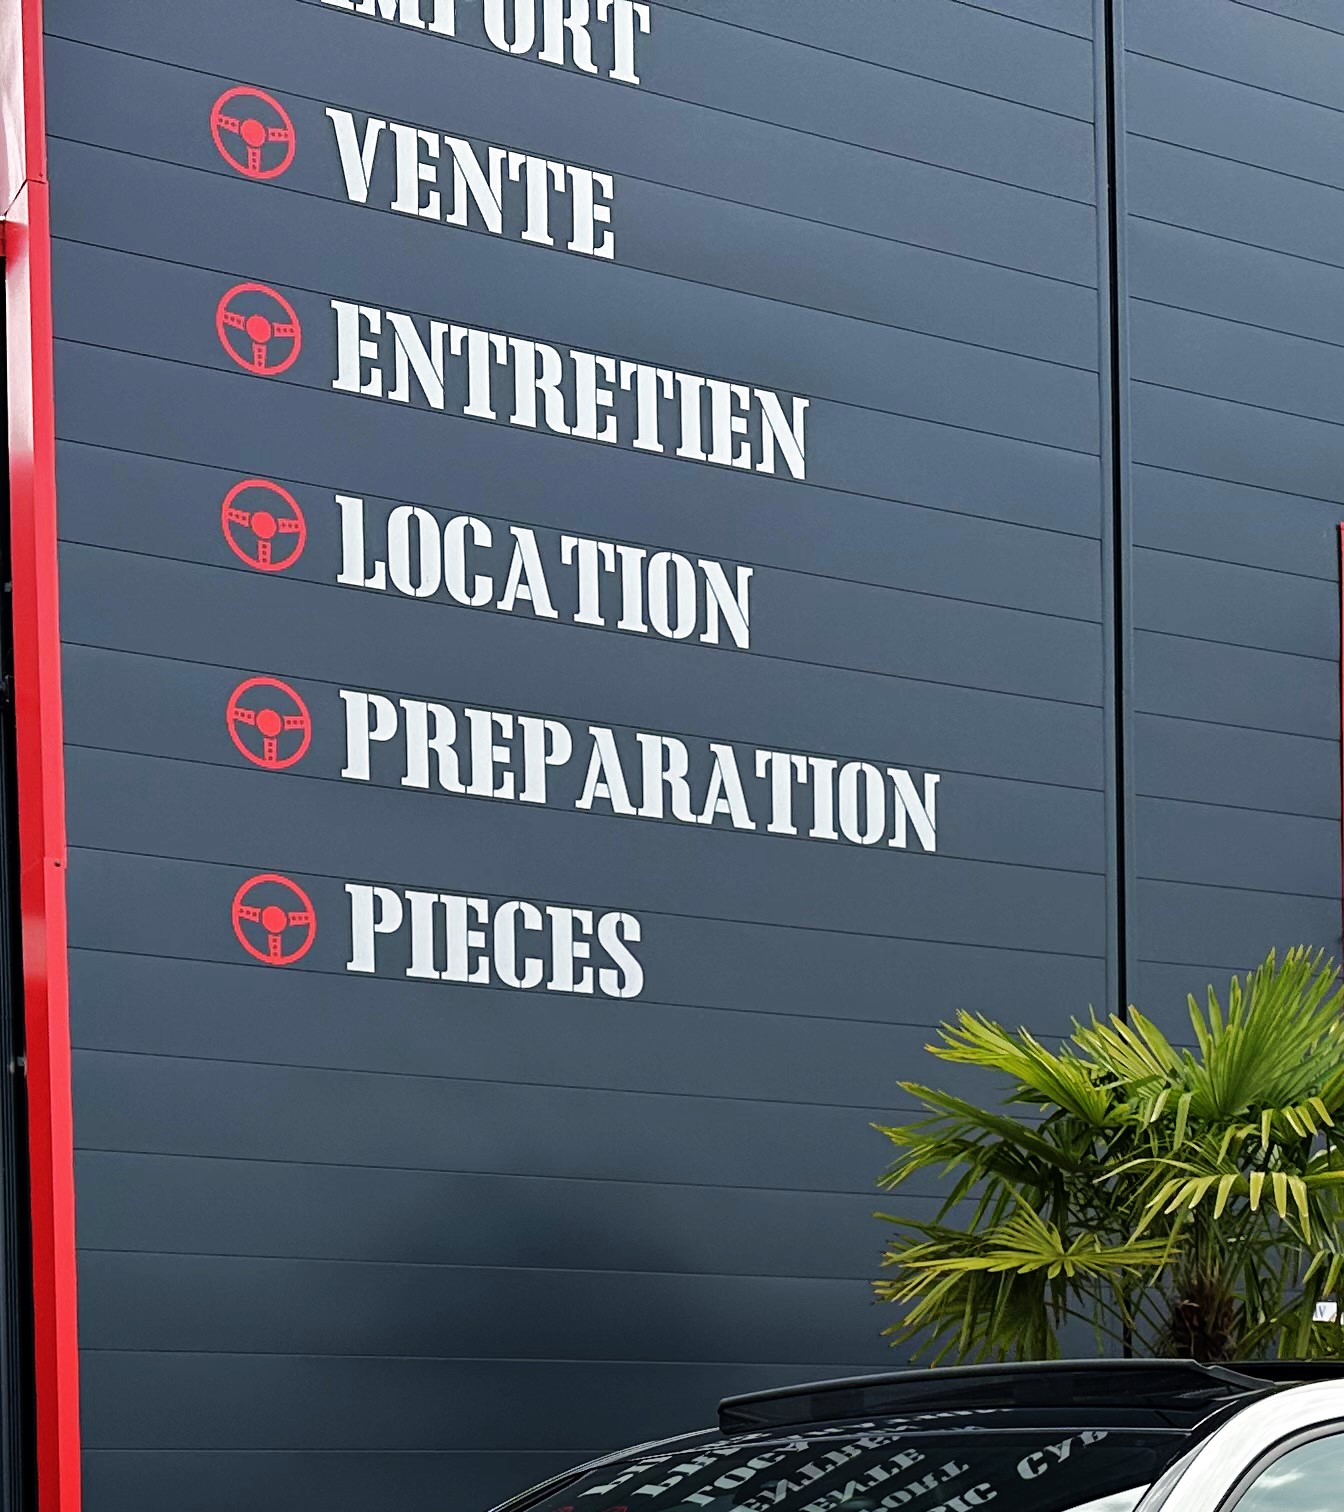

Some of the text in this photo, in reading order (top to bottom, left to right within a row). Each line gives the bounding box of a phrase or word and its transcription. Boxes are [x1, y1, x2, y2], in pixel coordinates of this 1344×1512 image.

[321, 0, 651, 85] ORT
[325, 107, 615, 260] VENTE
[330, 299, 810, 480] ENTRETIEN
[335, 494, 754, 649] LOCATION
[339, 689, 941, 852] PREPARATION
[345, 883, 644, 998] PIECES
